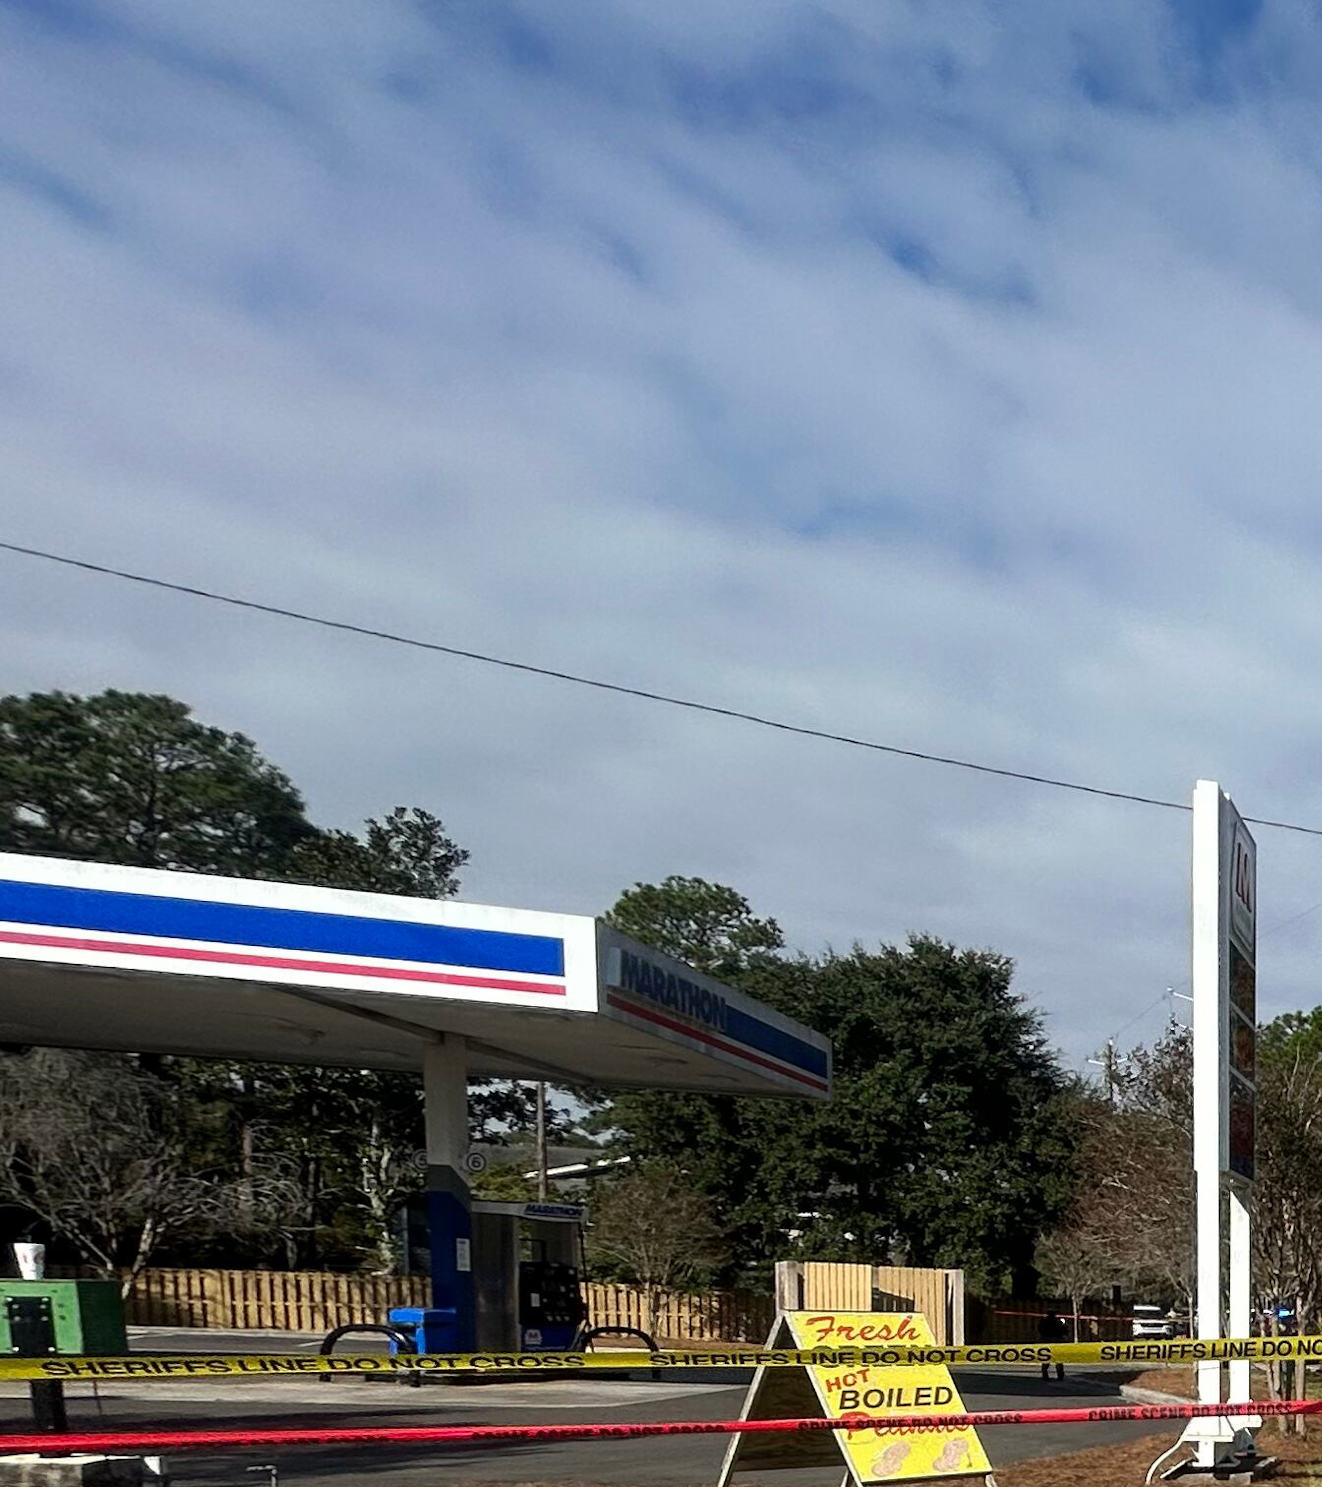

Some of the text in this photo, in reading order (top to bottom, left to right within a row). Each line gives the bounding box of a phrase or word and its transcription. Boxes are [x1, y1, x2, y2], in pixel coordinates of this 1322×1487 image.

[619, 949, 727, 1034] MARATHON
[806, 1314, 920, 1341] Fresh
[650, 1350, 790, 1366] SHERIFFS
[796, 1351, 855, 1365] LINE
[861, 1351, 900, 1365] DO
[906, 1350, 963, 1364] NOT
[966, 1347, 1052, 1363] CROSS
[1100, 1342, 1206, 1361] SHERIFFS
[1210, 1341, 1258, 1359] LINE
[1261, 1340, 1293, 1357] DO
[42, 1355, 586, 1376] SHERIFFS LINE DO NOT CROSS
[825, 1369, 870, 1393] HOT
[839, 1386, 953, 1410] BOILED
[1088, 1409, 1136, 1421] CRIME
[1141, 1407, 1186, 1419] SCENE
[1215, 1404, 1245, 1416] NOT
[1248, 1402, 1291, 1414] CROSS
